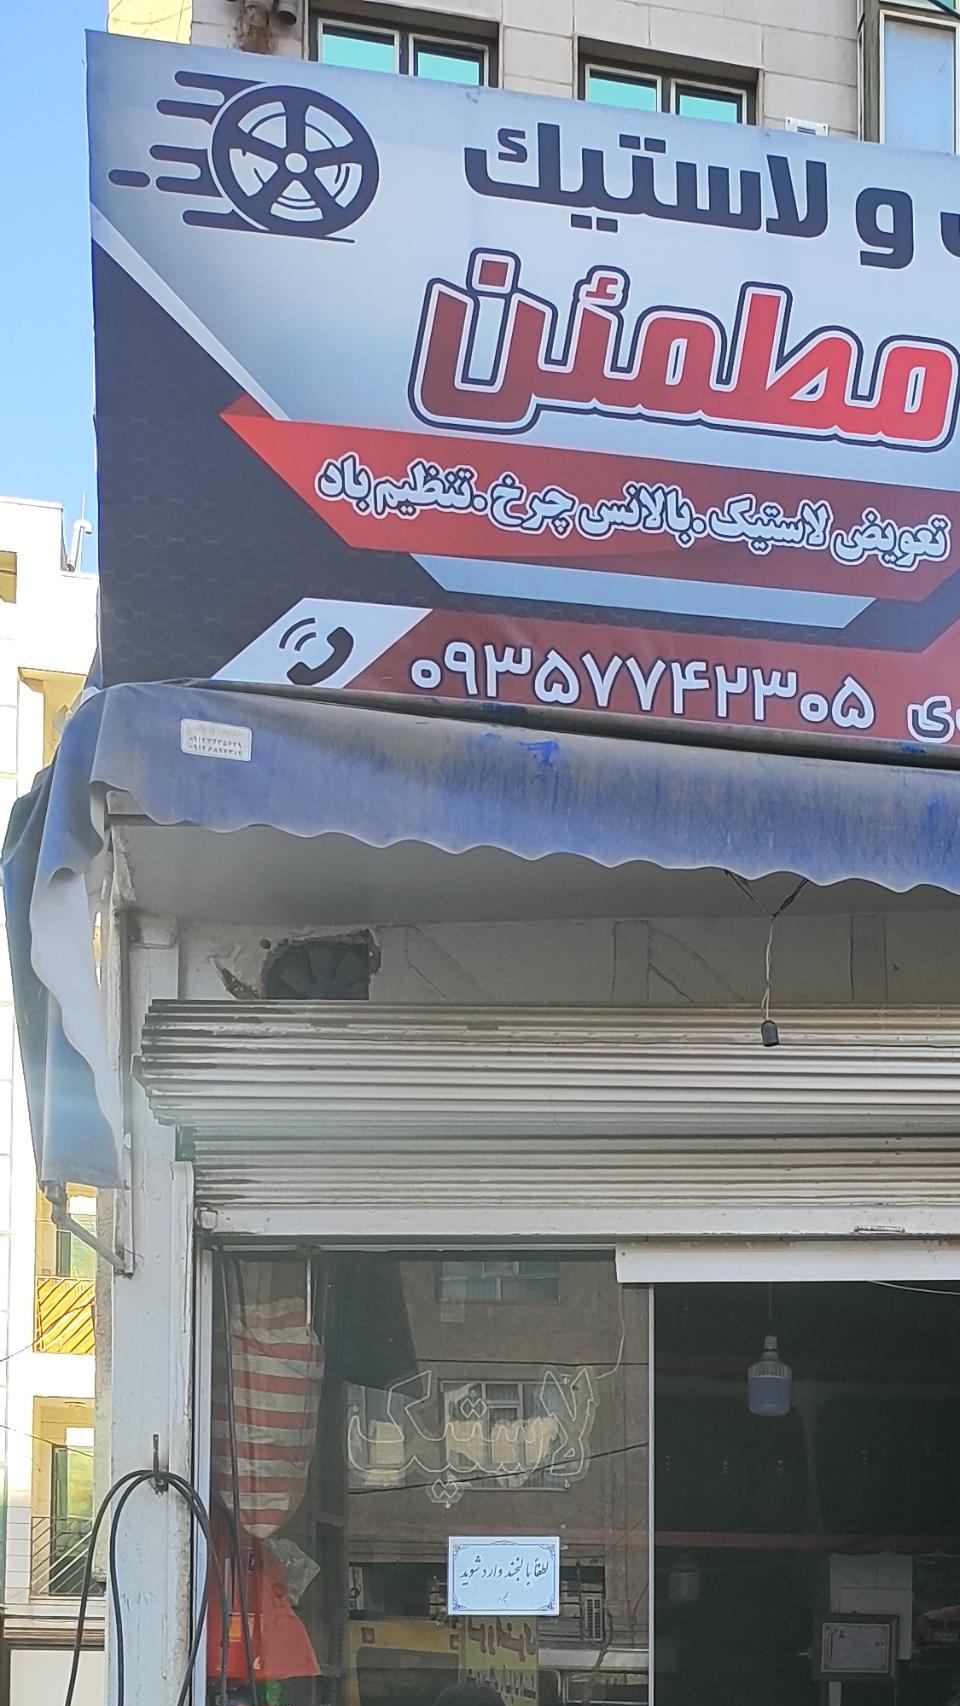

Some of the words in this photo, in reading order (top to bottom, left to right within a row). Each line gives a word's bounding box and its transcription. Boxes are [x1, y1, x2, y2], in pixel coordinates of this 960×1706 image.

[855, 187, 915, 270] و
[315, 452, 375, 517] باد
[488, 471, 578, 540] چرخ
[831, 506, 952, 572] تعویض
[410, 641, 877, 730] ۰۹۳۵۷۷۴۲۳۰۵
[460, 1555, 482, 1586] شوید
[481, 1564, 503, 1578] وارد
[503, 1557, 524, 1582] لبخند
